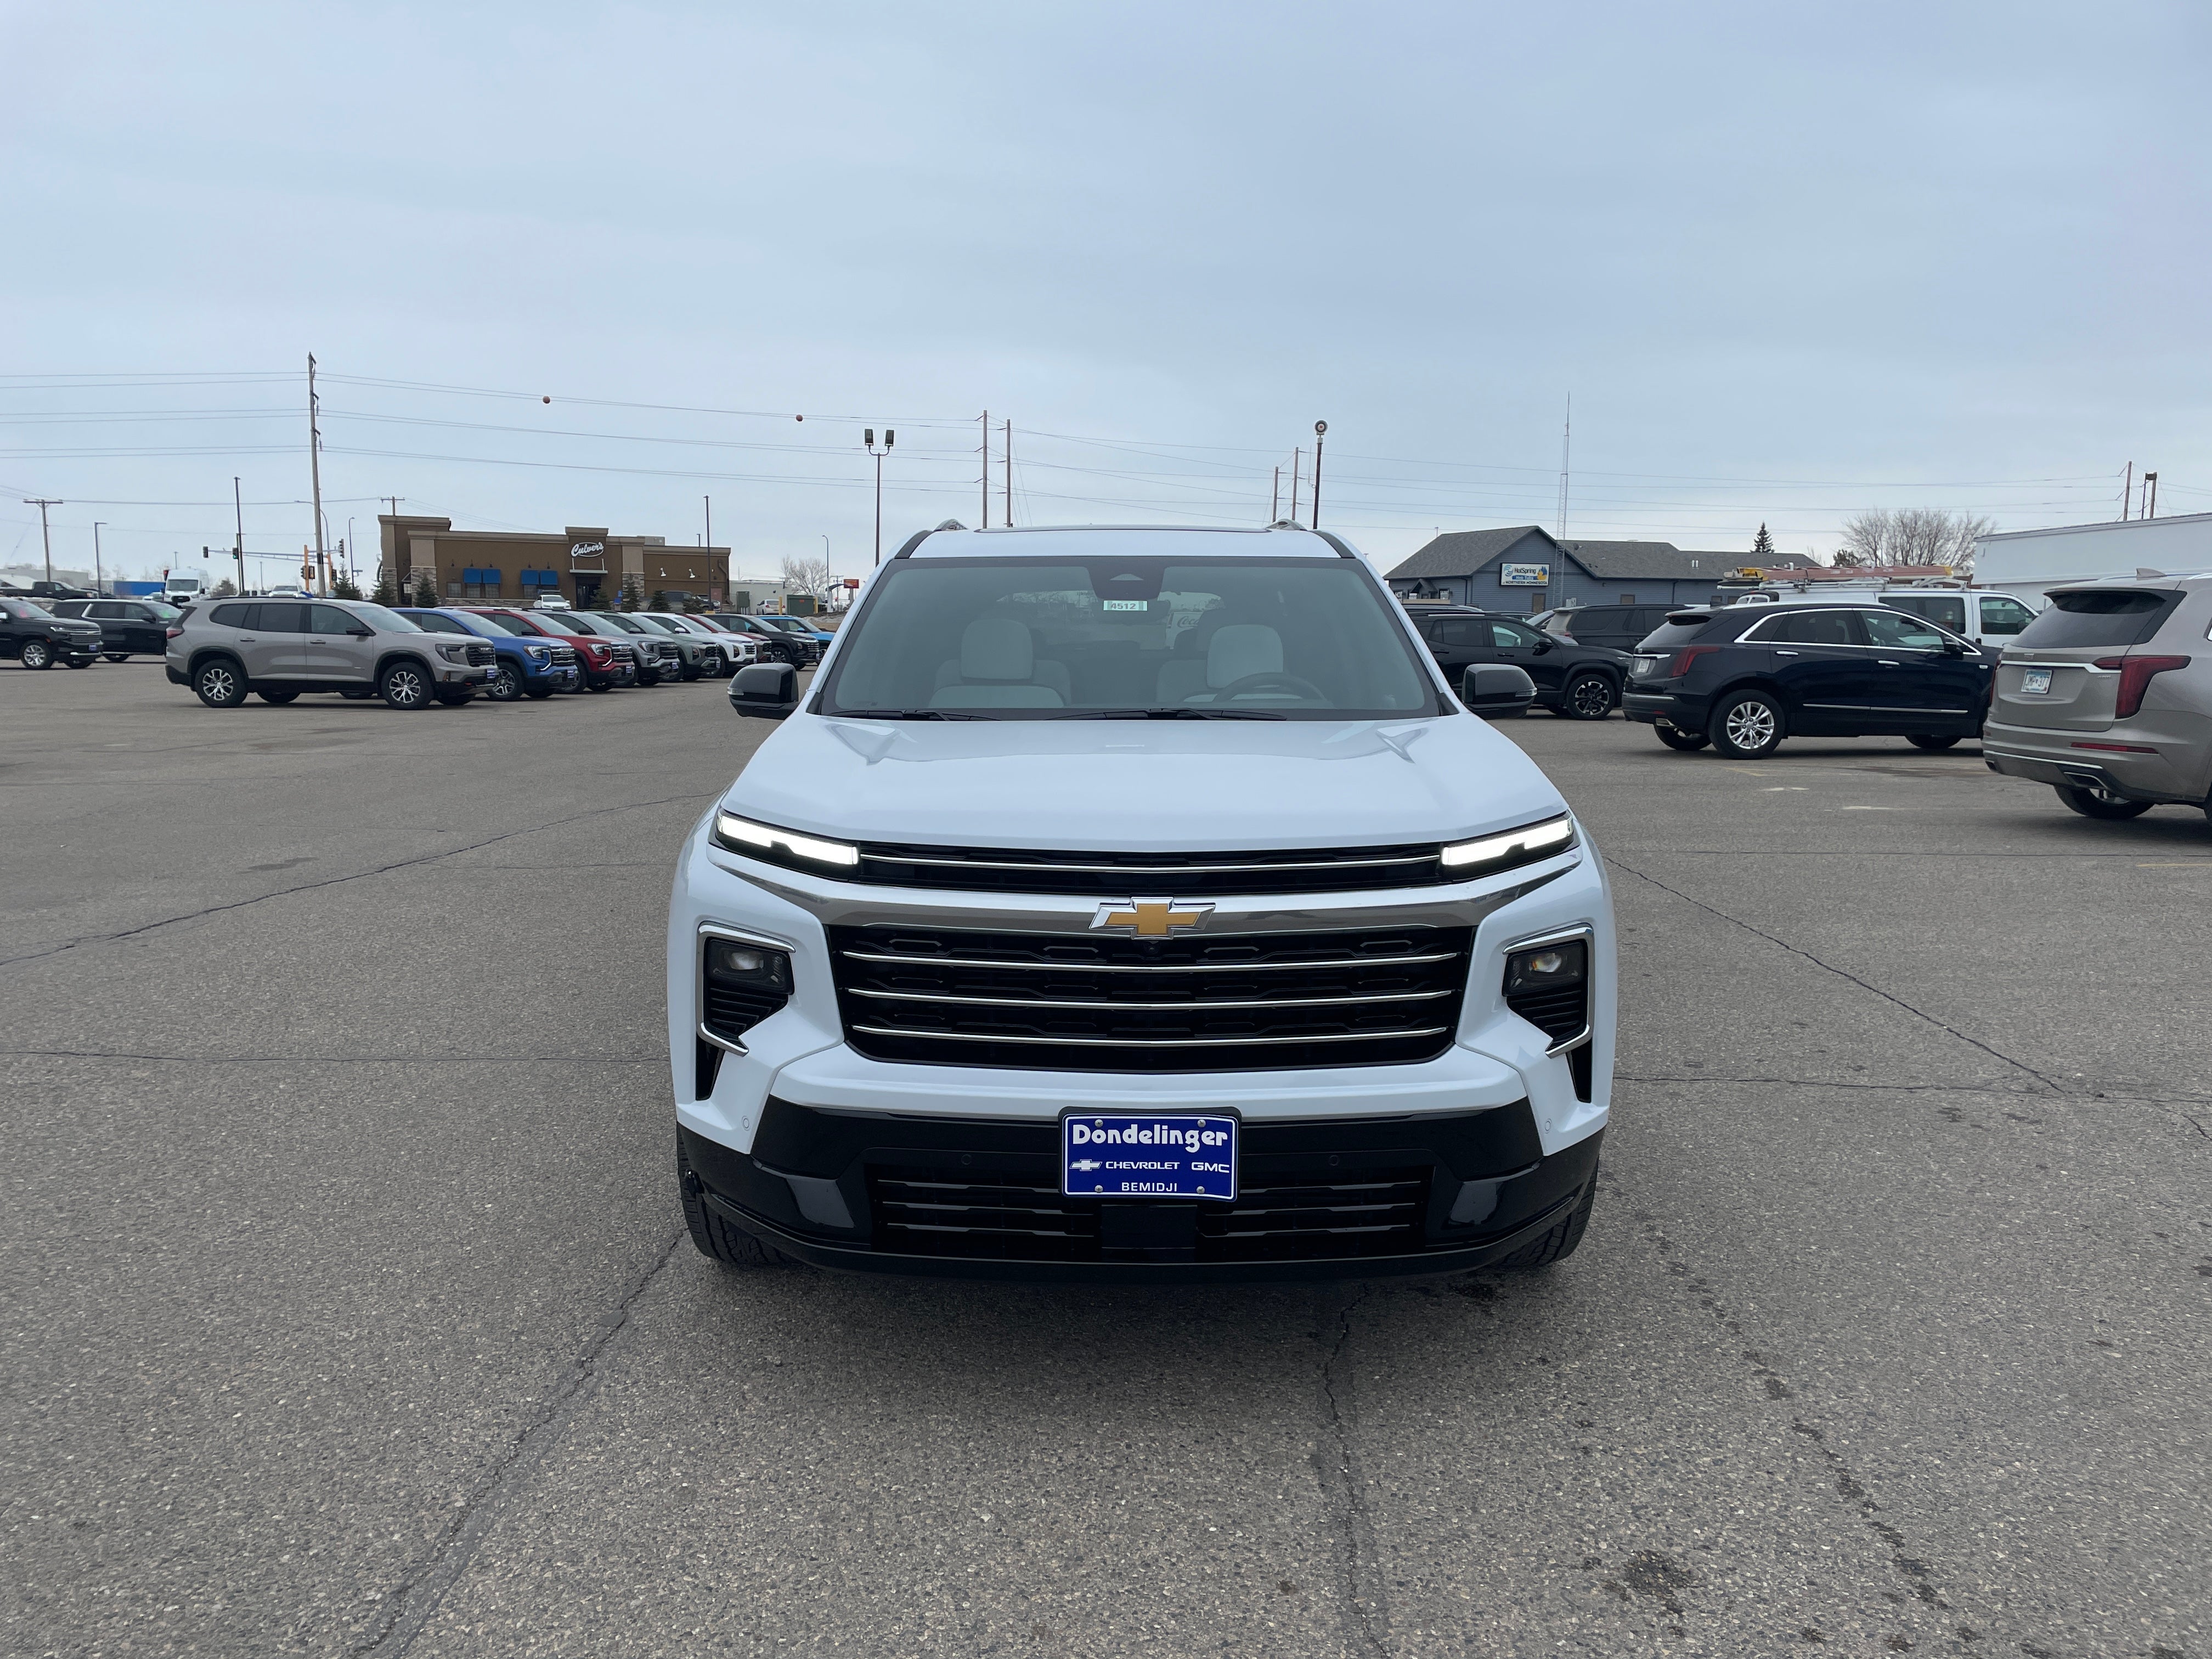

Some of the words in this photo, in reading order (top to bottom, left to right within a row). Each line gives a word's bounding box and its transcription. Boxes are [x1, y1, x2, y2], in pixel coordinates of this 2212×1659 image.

[571, 542, 604, 557] Culver's
[1073, 1124, 1228, 1153] Dondelinger
[1105, 1161, 1180, 1170] CHEVROLET
[1191, 1162, 1230, 1173] GMC
[1121, 1182, 1177, 1192] BEMIDJI
